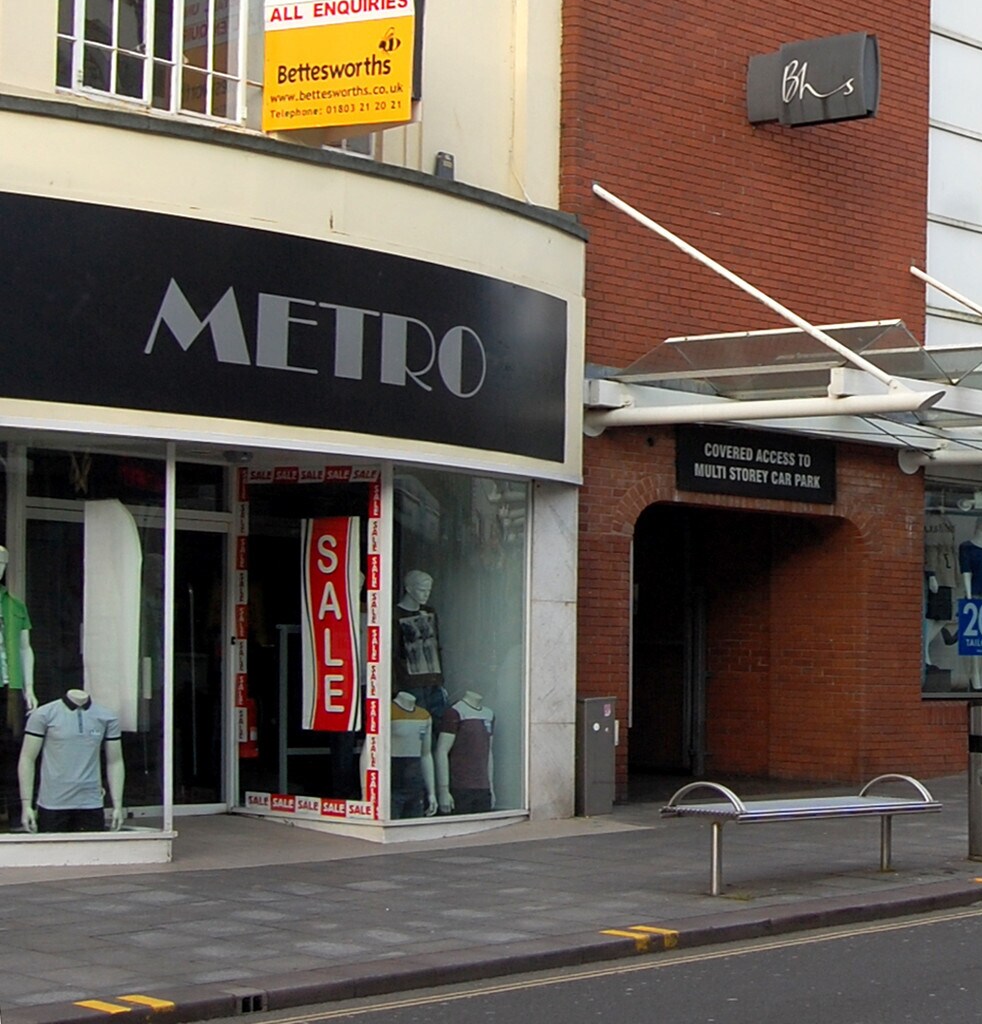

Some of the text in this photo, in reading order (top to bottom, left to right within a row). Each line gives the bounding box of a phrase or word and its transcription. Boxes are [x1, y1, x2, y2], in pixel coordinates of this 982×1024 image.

[270, 5, 303, 23] ALL
[277, 53, 392, 85] Bettesworths
[782, 59, 855, 103] Bhs
[270, 82, 404, 104] www.bettesworths.co.uk
[269, 100, 402, 120] Telephone: 01803 21 20 21
[144, 277, 486, 399] METRO
[704, 442, 812, 468] COVERED ACCESS TO
[250, 470, 272, 481] SALE
[275, 469, 297, 481] SALE
[301, 470, 323, 480] SALE
[327, 469, 349, 480] SALE
[353, 469, 378, 480] SALE
[694, 463, 821, 489] MULTI STOREY CAR PARK
[316, 534, 345, 713] SALE
[248, 795, 270, 807] SALE
[271, 797, 294, 809] SALE
[297, 799, 319, 811] SALE
[322, 801, 346, 814] SALE
[348, 804, 372, 816] SALE
